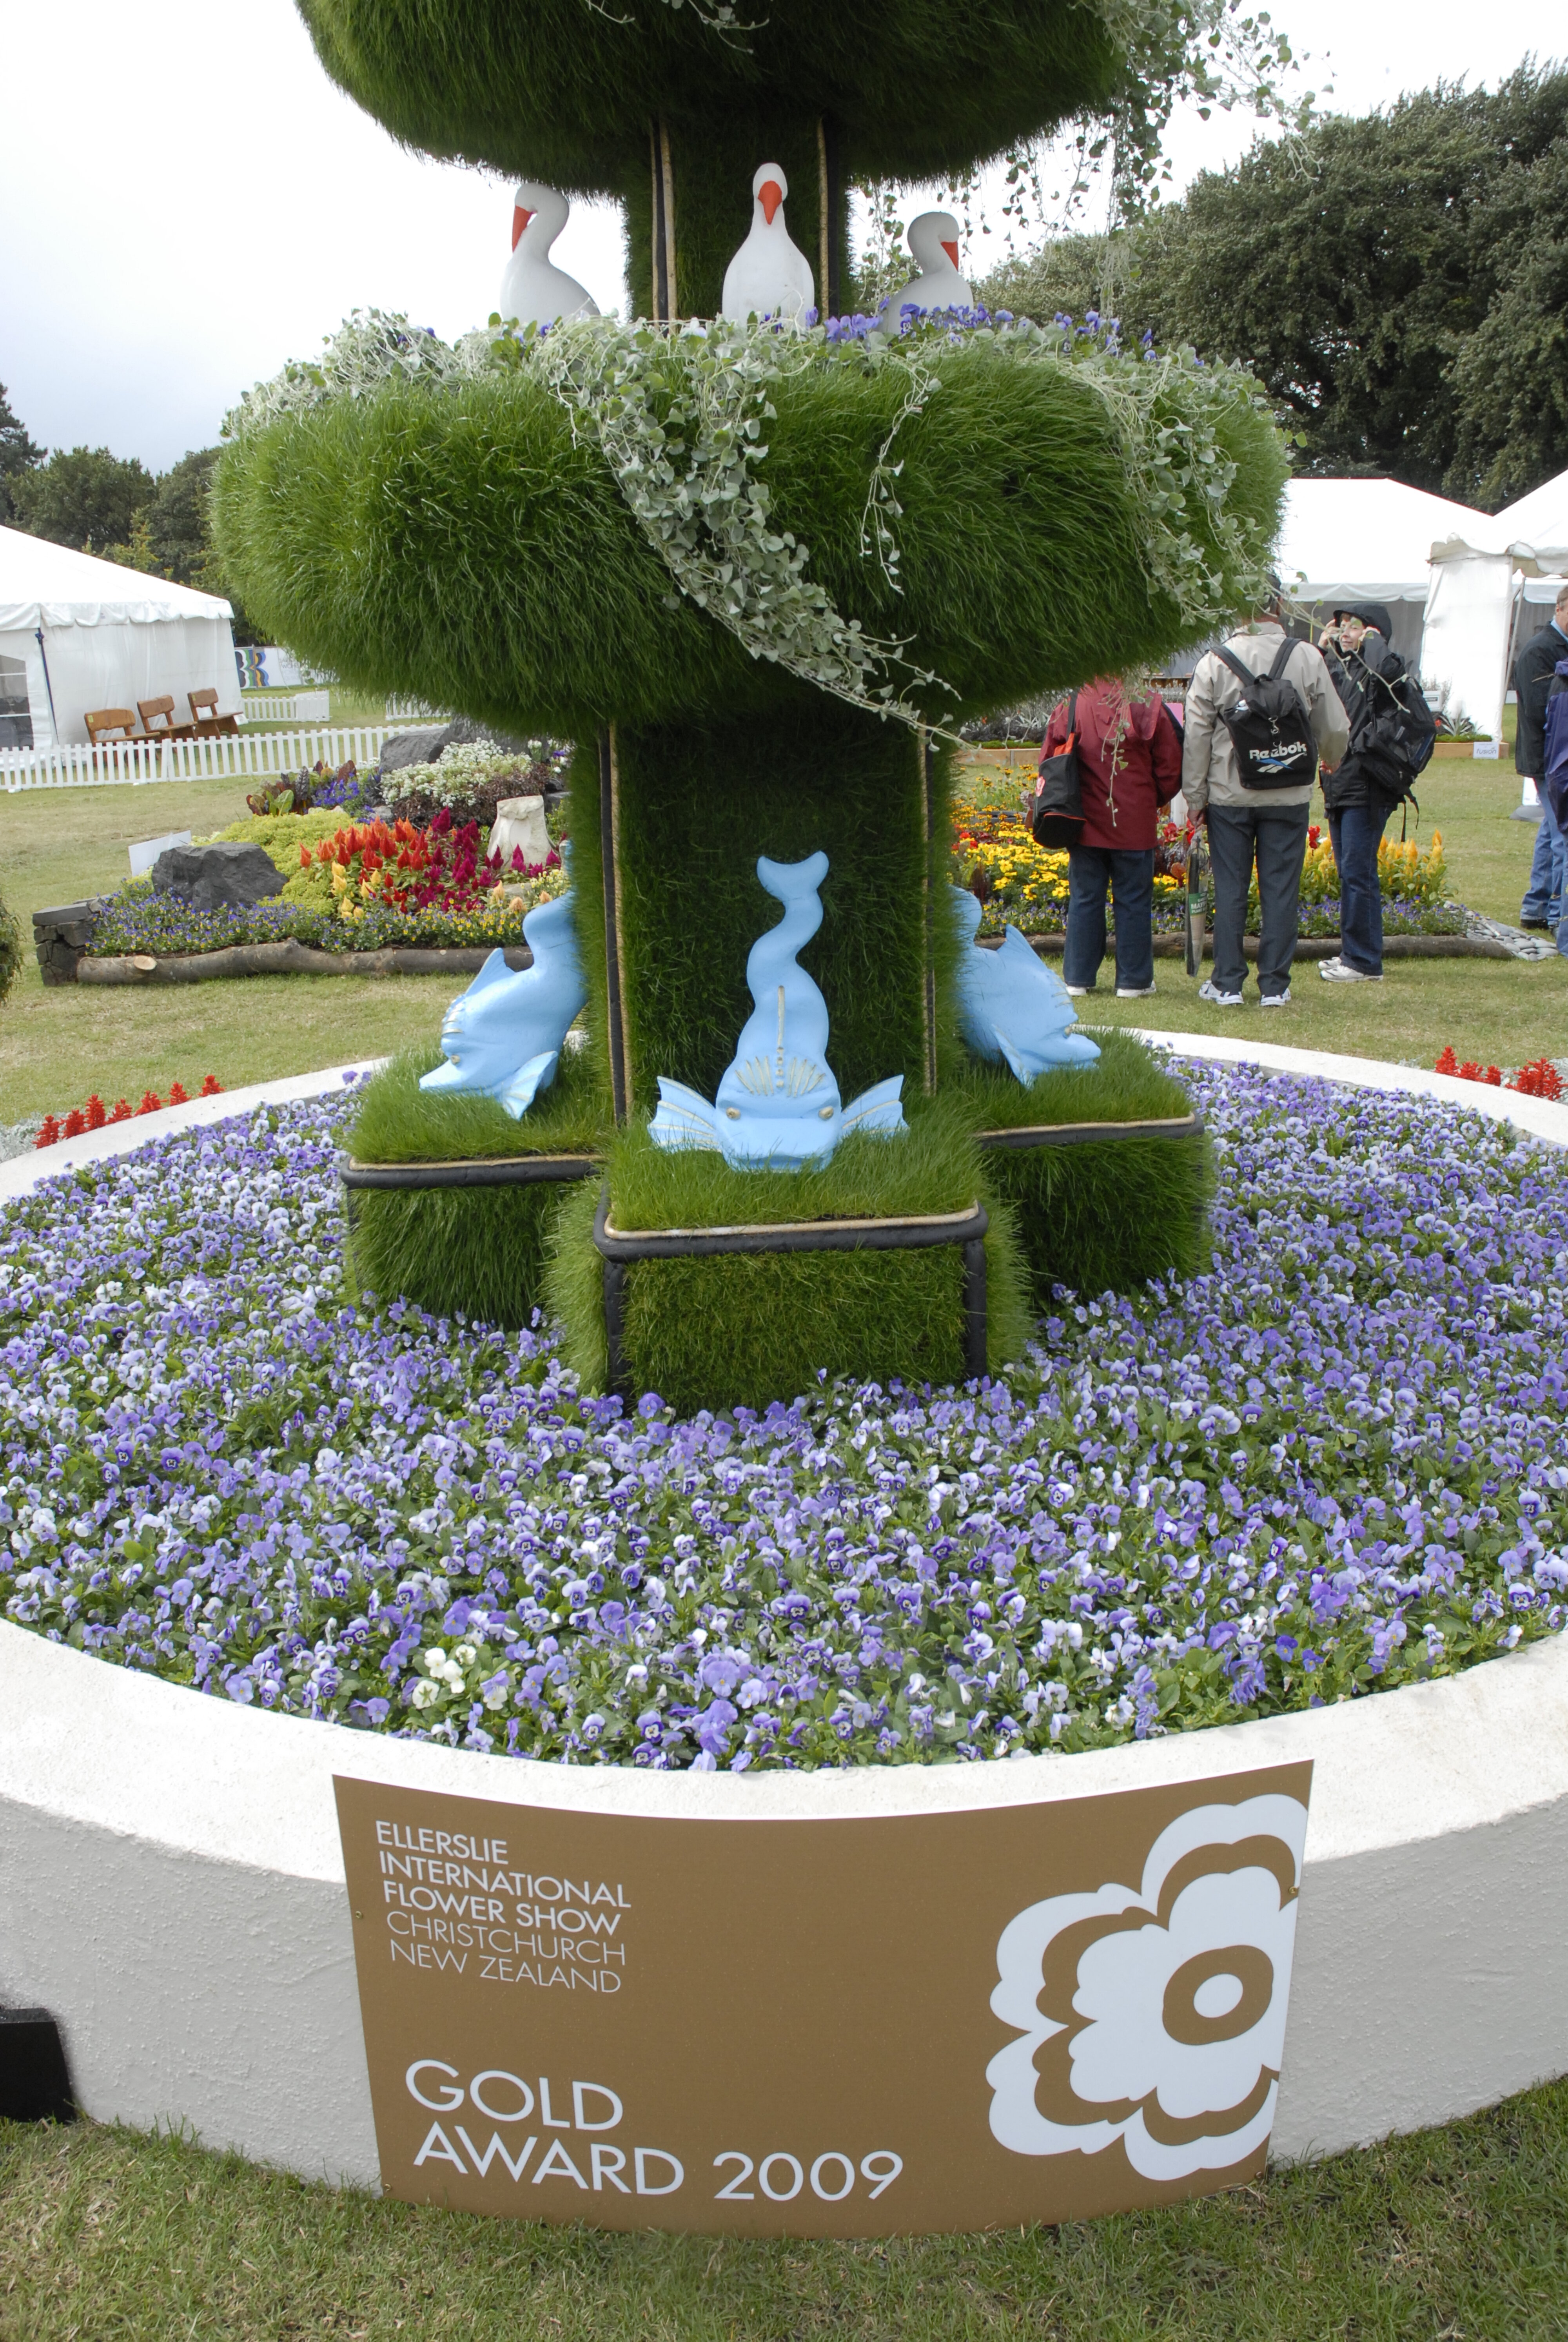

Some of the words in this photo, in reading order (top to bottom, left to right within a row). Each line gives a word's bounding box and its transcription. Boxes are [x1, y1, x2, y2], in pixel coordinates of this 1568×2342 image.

[1249, 741, 1307, 760] Reebok
[376, 1820, 508, 1865] ELLERSLIE
[379, 1850, 631, 1908] INTERNATIONAL
[383, 1880, 506, 1923] FLOWER
[516, 1903, 621, 1935] SHOW
[387, 1911, 625, 1965] CHRISTCHURCH
[390, 1939, 467, 1973] NEW
[479, 1956, 621, 1992] ZEALAND
[406, 2059, 623, 2130] GOLD
[414, 2121, 684, 2195] AWARD
[713, 2151, 903, 2201] 2009
